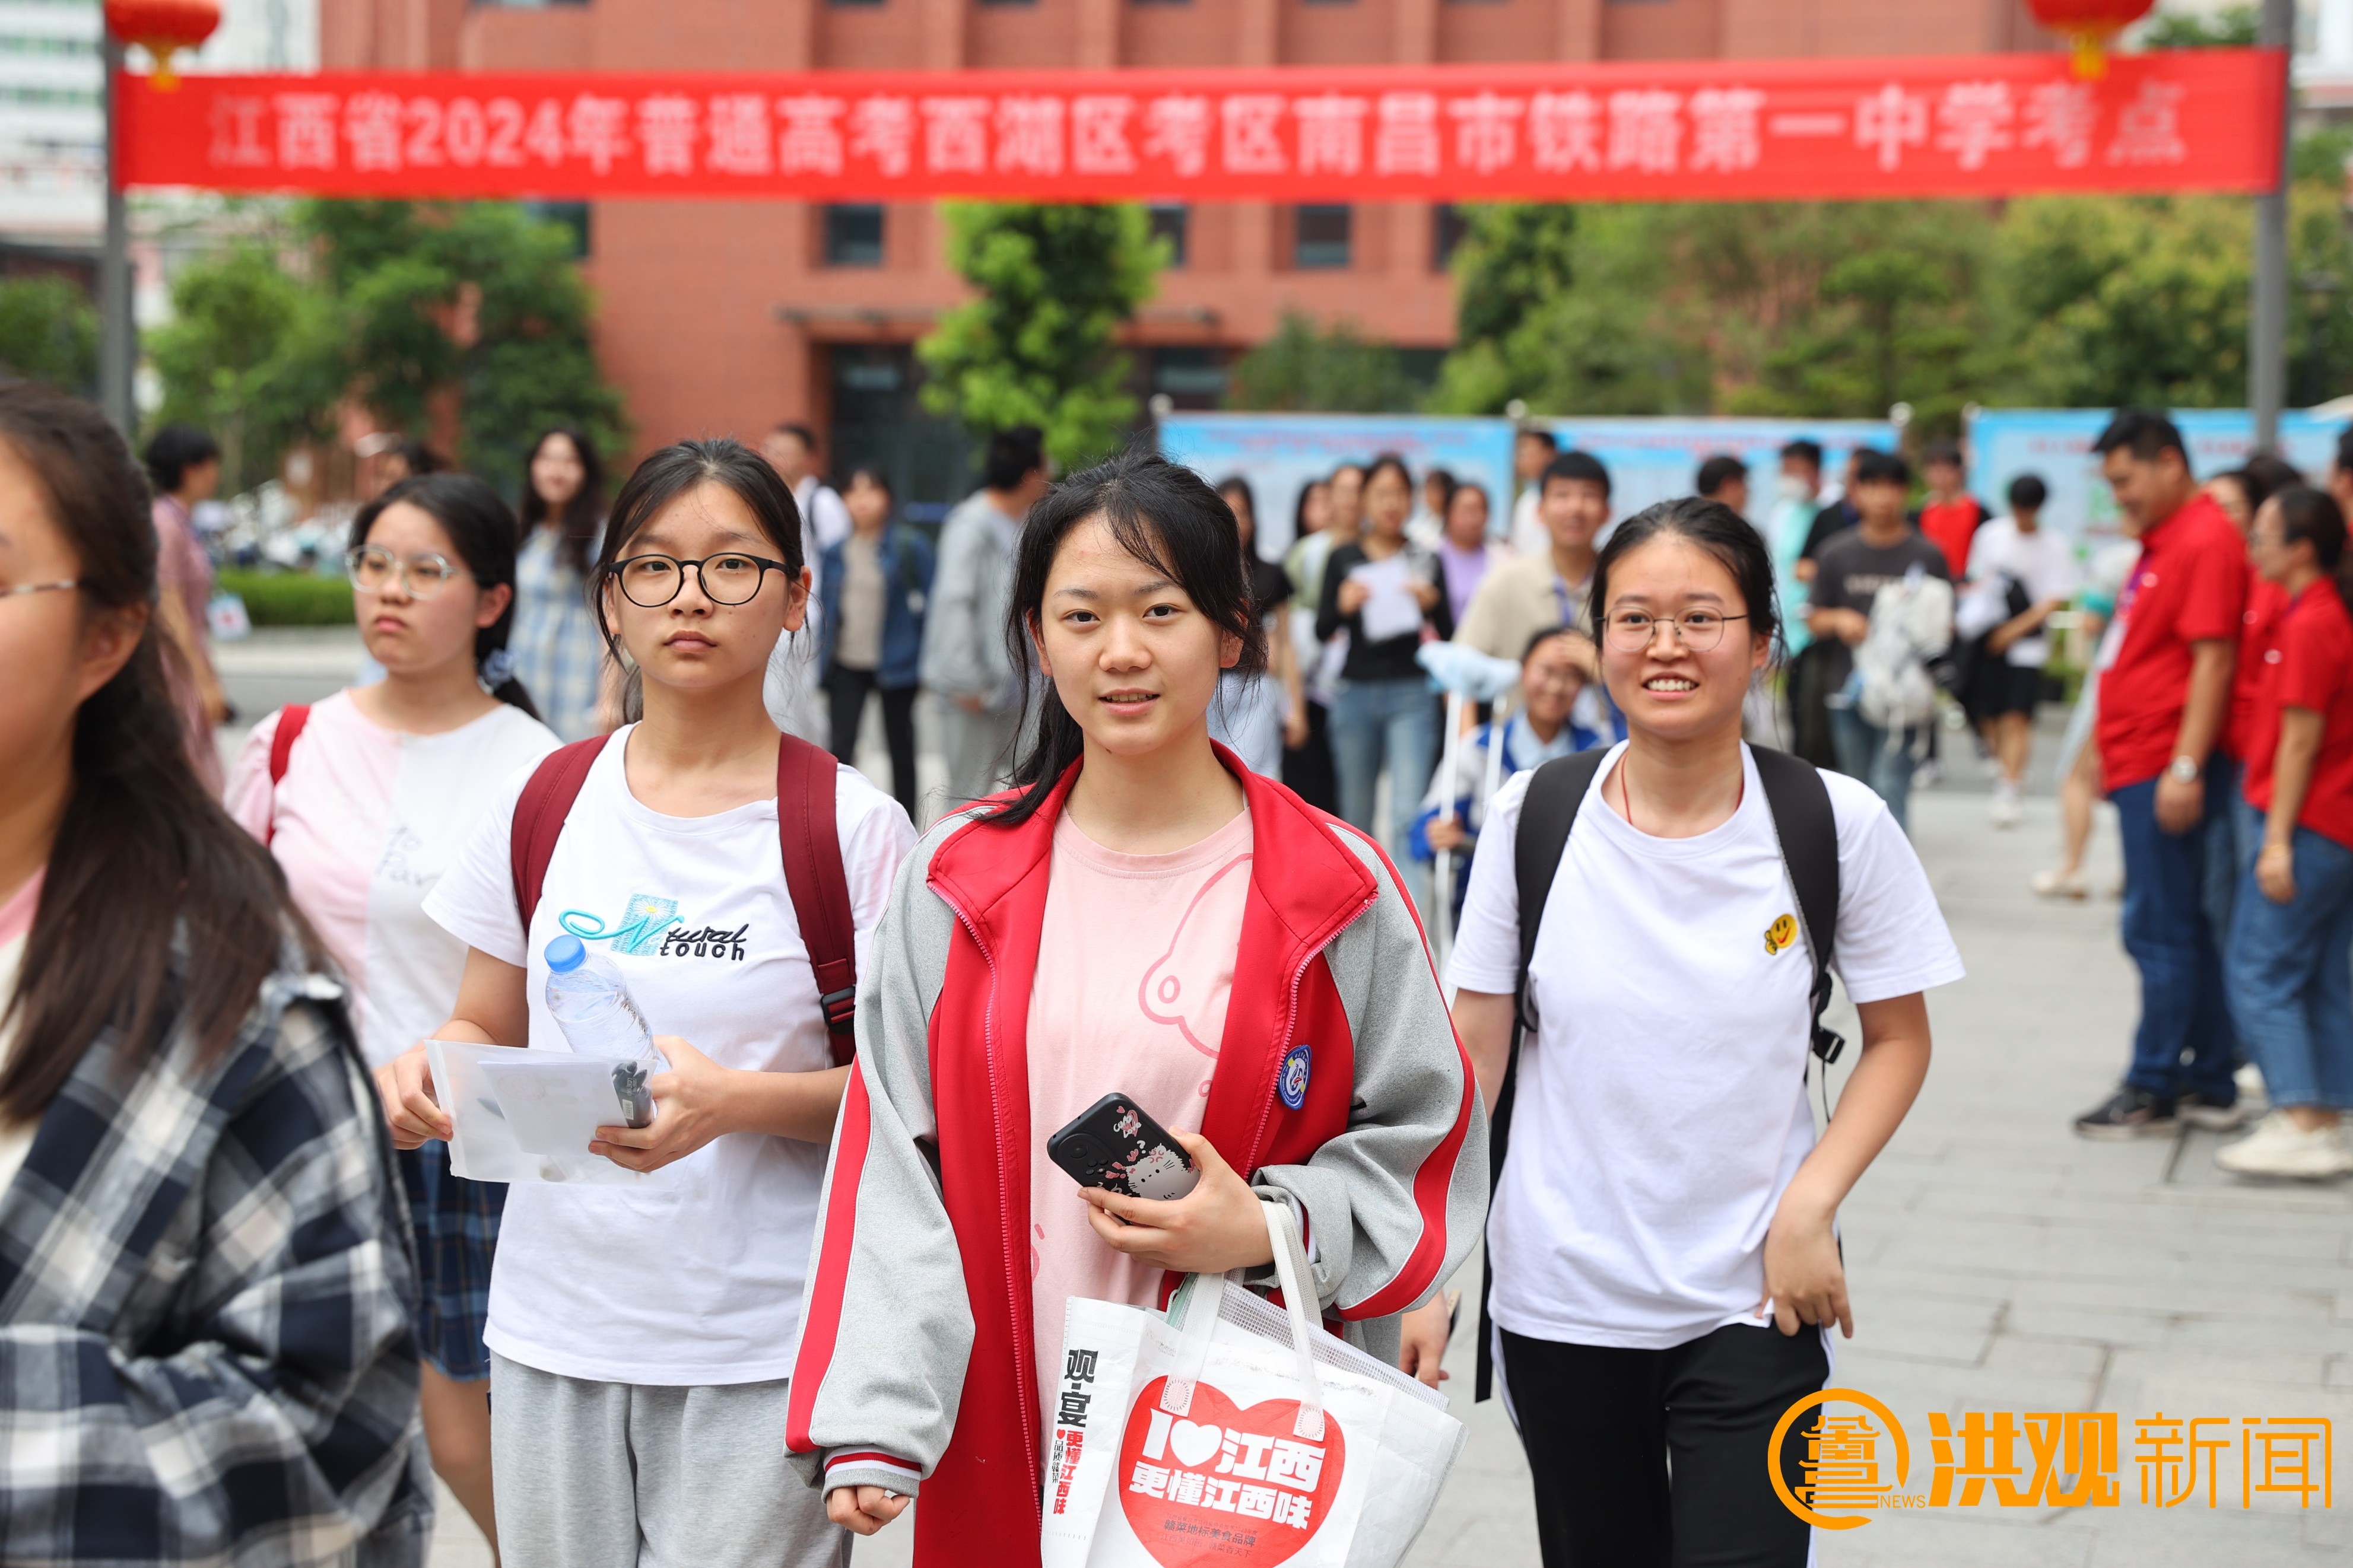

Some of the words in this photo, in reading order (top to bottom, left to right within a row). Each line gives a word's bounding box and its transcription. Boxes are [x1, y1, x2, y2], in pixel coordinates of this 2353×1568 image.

[208, 82, 2187, 176] 江西省2024年普通高考西湖区考区南昌市铁路第一中学考点
[660, 942, 744, 960] touch
[1052, 1440, 1063, 1483] 品质赣菜
[1053, 1430, 1083, 1515] 更懂江西味
[1214, 1427, 1326, 1493] 江西
[1129, 1461, 1313, 1531] 更懂江西味
[1164, 1519, 1256, 1547] 赣菜地标美食品牌
